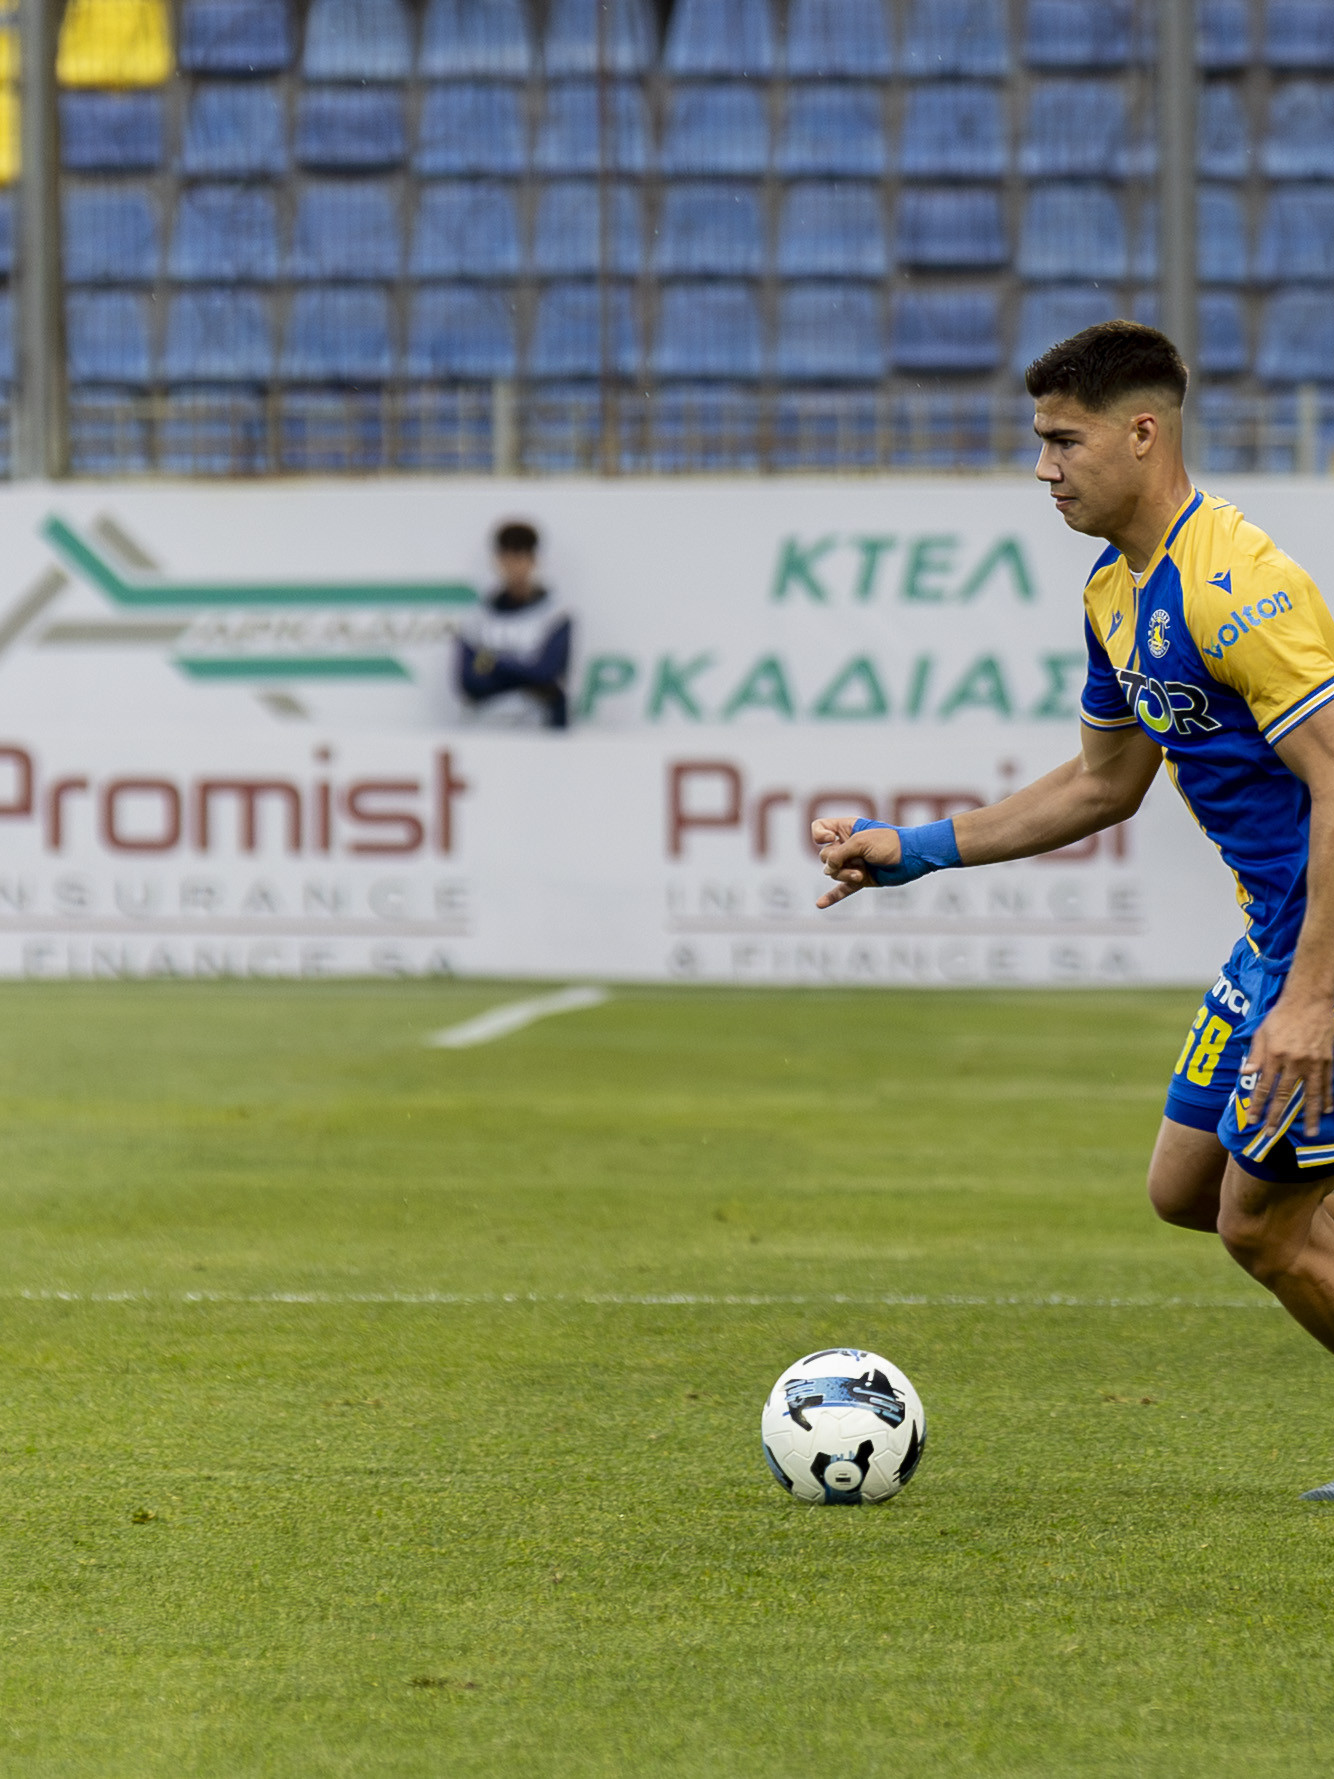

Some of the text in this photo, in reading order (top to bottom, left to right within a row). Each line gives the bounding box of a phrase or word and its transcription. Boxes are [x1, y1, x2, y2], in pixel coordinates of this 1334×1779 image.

[771, 533, 1038, 604] ΚΤΕΛ
[1203, 589, 1294, 661] volton
[578, 649, 1086, 722] ΡΚΑΔΙΑΣ
[1113, 666, 1222, 735] TOR
